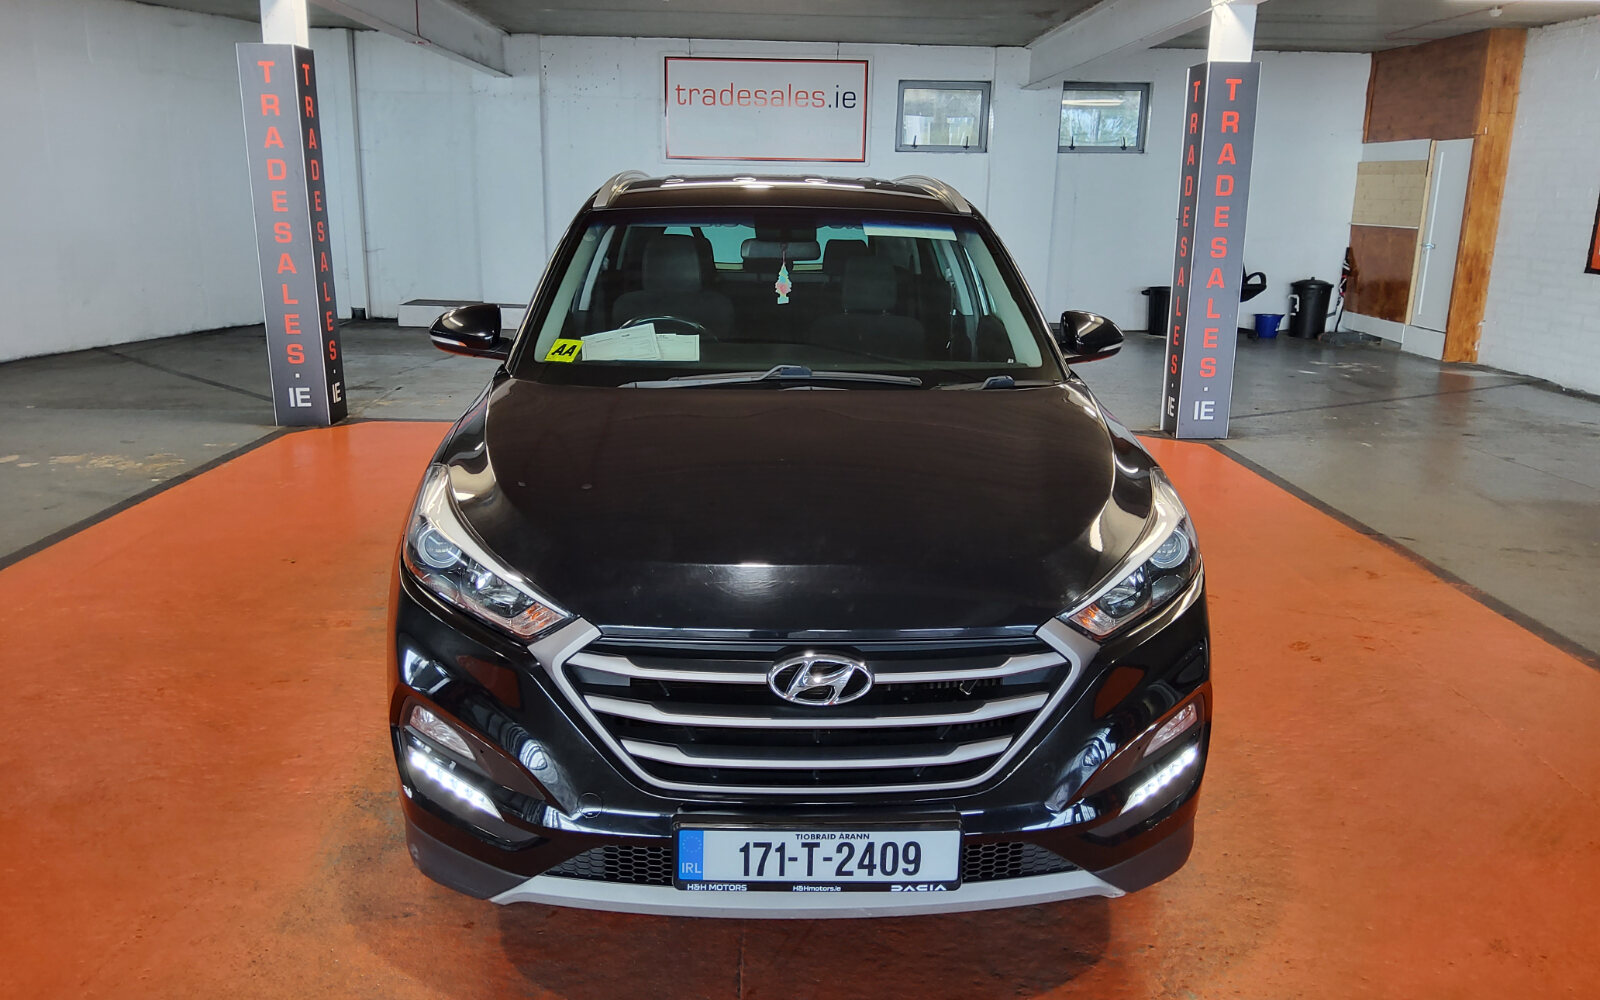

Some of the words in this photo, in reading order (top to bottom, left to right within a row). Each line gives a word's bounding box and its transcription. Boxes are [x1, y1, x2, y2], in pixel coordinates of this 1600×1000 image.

[675, 82, 857, 109] tradesales.ie
[551, 343, 577, 357] AA
[738, 841, 922, 877] 171-T-2409
[681, 862, 702, 874] IRL
[687, 883, 707, 891] H&H
[708, 884, 748, 892] MOTORS
[890, 884, 947, 892] DACIA
